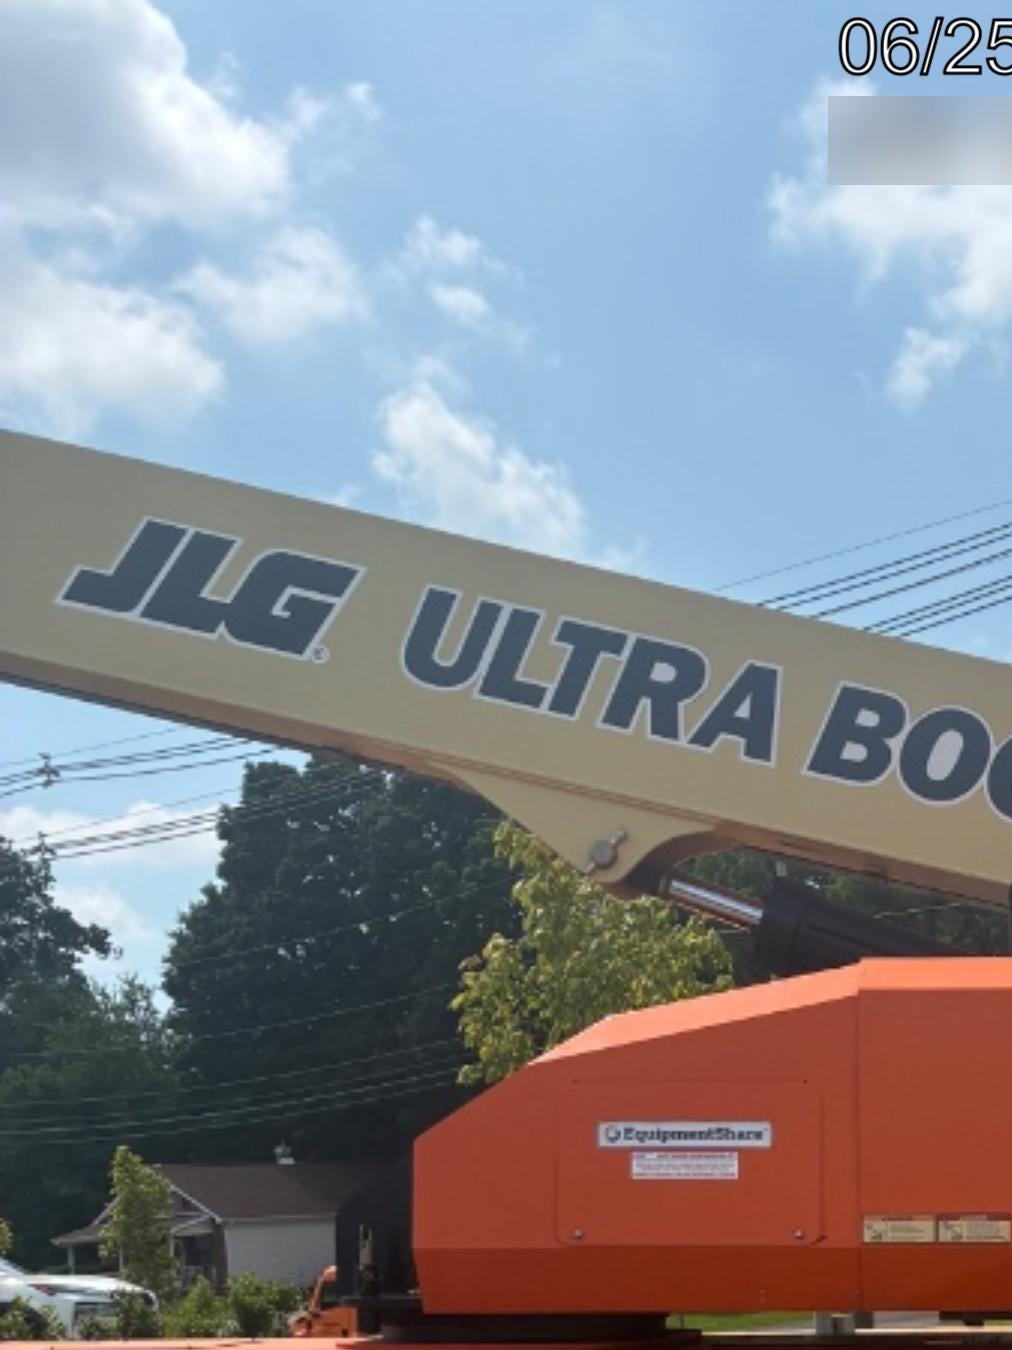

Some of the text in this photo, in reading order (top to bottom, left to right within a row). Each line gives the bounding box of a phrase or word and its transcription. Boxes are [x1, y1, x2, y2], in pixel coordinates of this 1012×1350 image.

[57, 517, 366, 661] JLG
[402, 584, 783, 768] ULTRA
[623, 1126, 764, 1144] EquipmentShare
